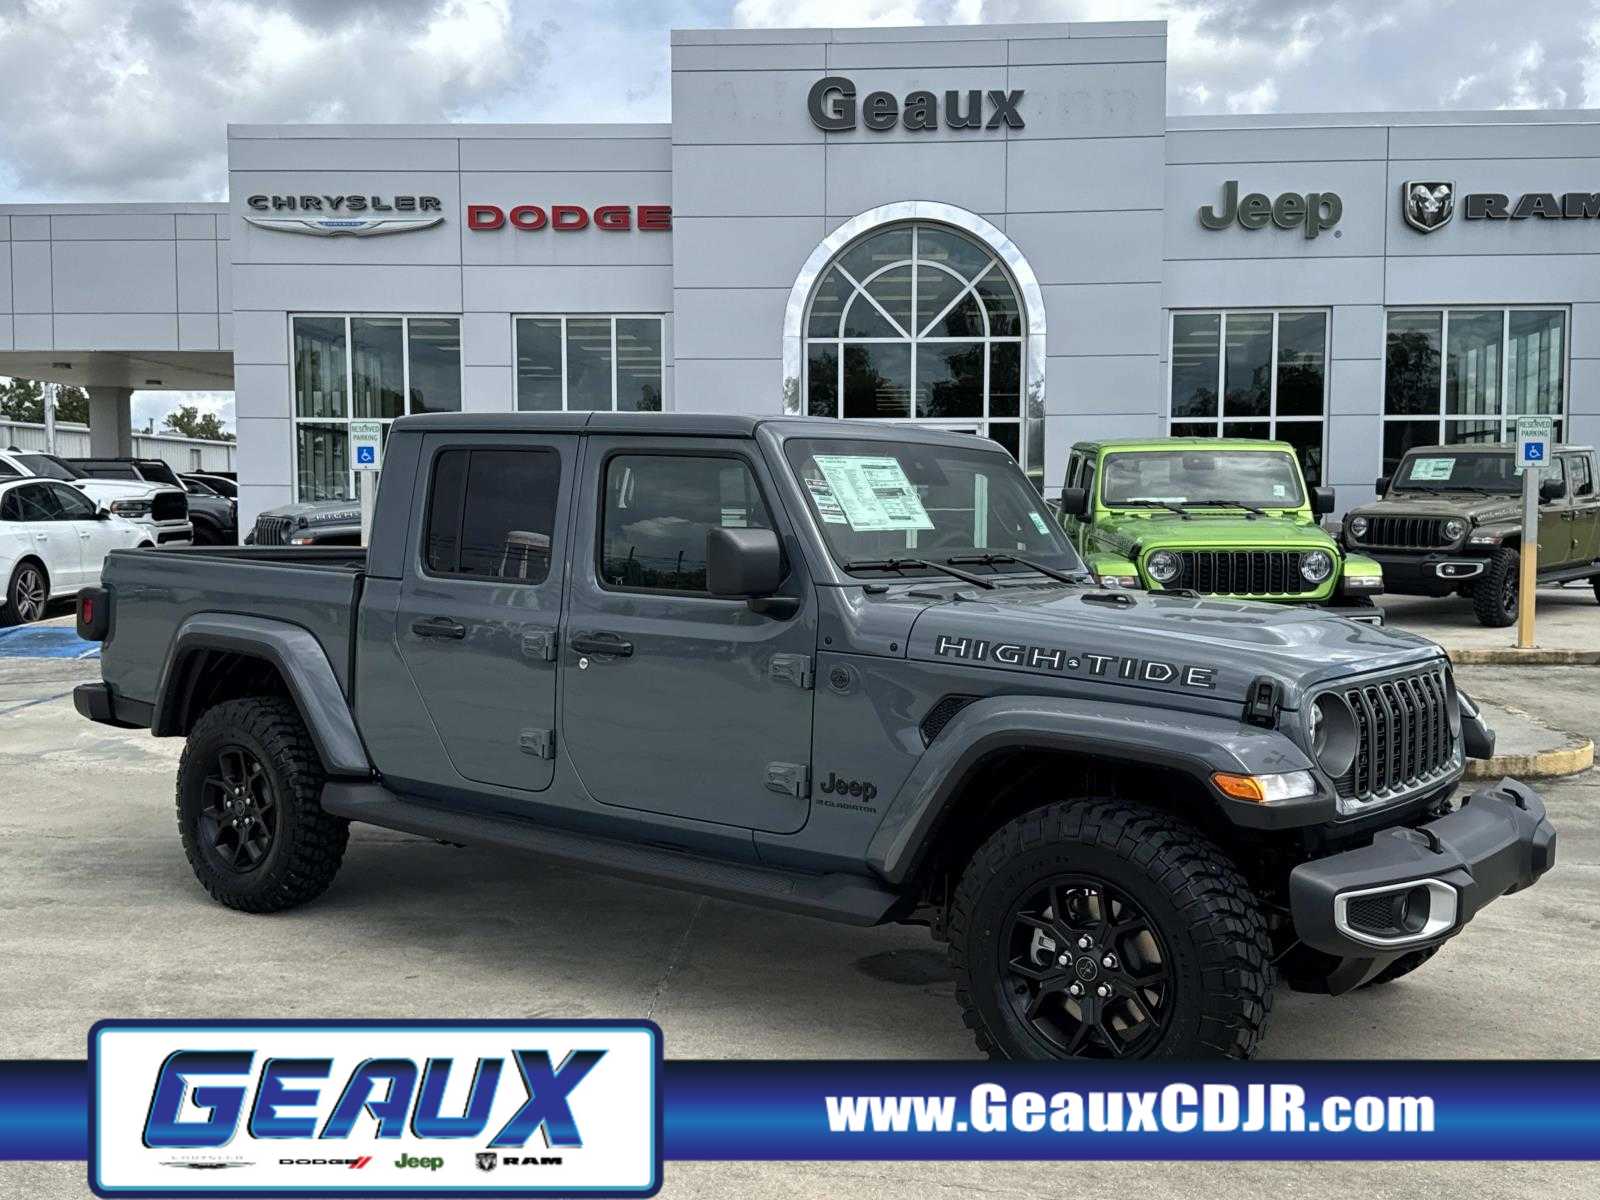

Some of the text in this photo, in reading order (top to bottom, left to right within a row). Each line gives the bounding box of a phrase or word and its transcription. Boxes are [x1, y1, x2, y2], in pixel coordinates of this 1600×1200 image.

[808, 76, 1025, 131] Geaux
[247, 195, 442, 212] CHRYSLER
[1200, 181, 1343, 239] Jeep
[1465, 193, 1600, 220] RAM
[468, 205, 672, 231] DODGE
[353, 433, 378, 441] PARKING
[821, 772, 877, 802] Jeep
